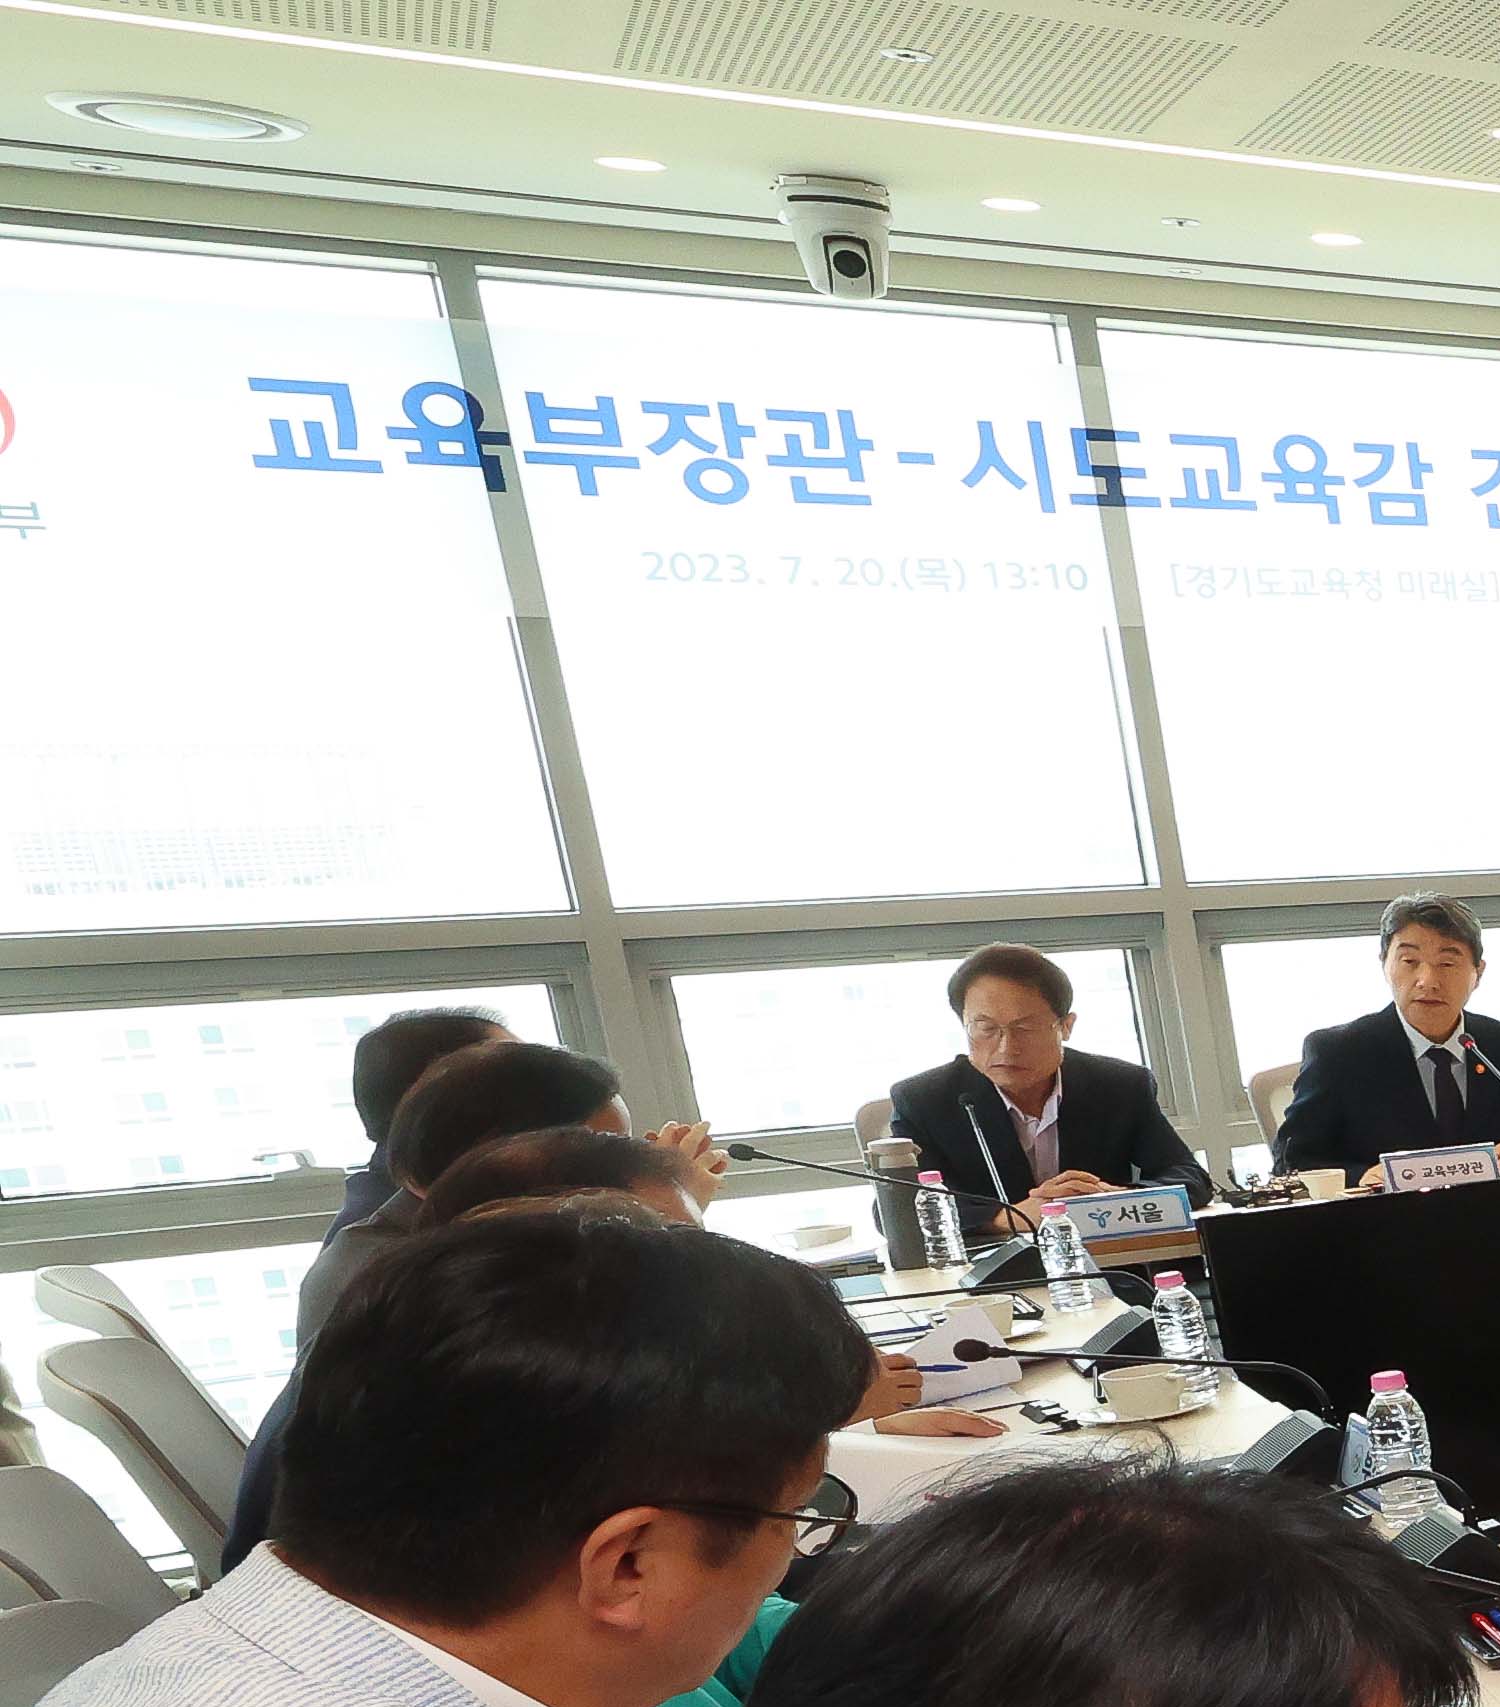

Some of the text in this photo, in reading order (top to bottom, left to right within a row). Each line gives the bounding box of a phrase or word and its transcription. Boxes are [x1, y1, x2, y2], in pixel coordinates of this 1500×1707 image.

[640, 550, 768, 585] 2023.
[779, 556, 821, 585] 7.
[983, 560, 1090, 593] 13:10
[1421, 1161, 1485, 1179] 교육부장관
[1116, 1201, 1165, 1227] 서울
